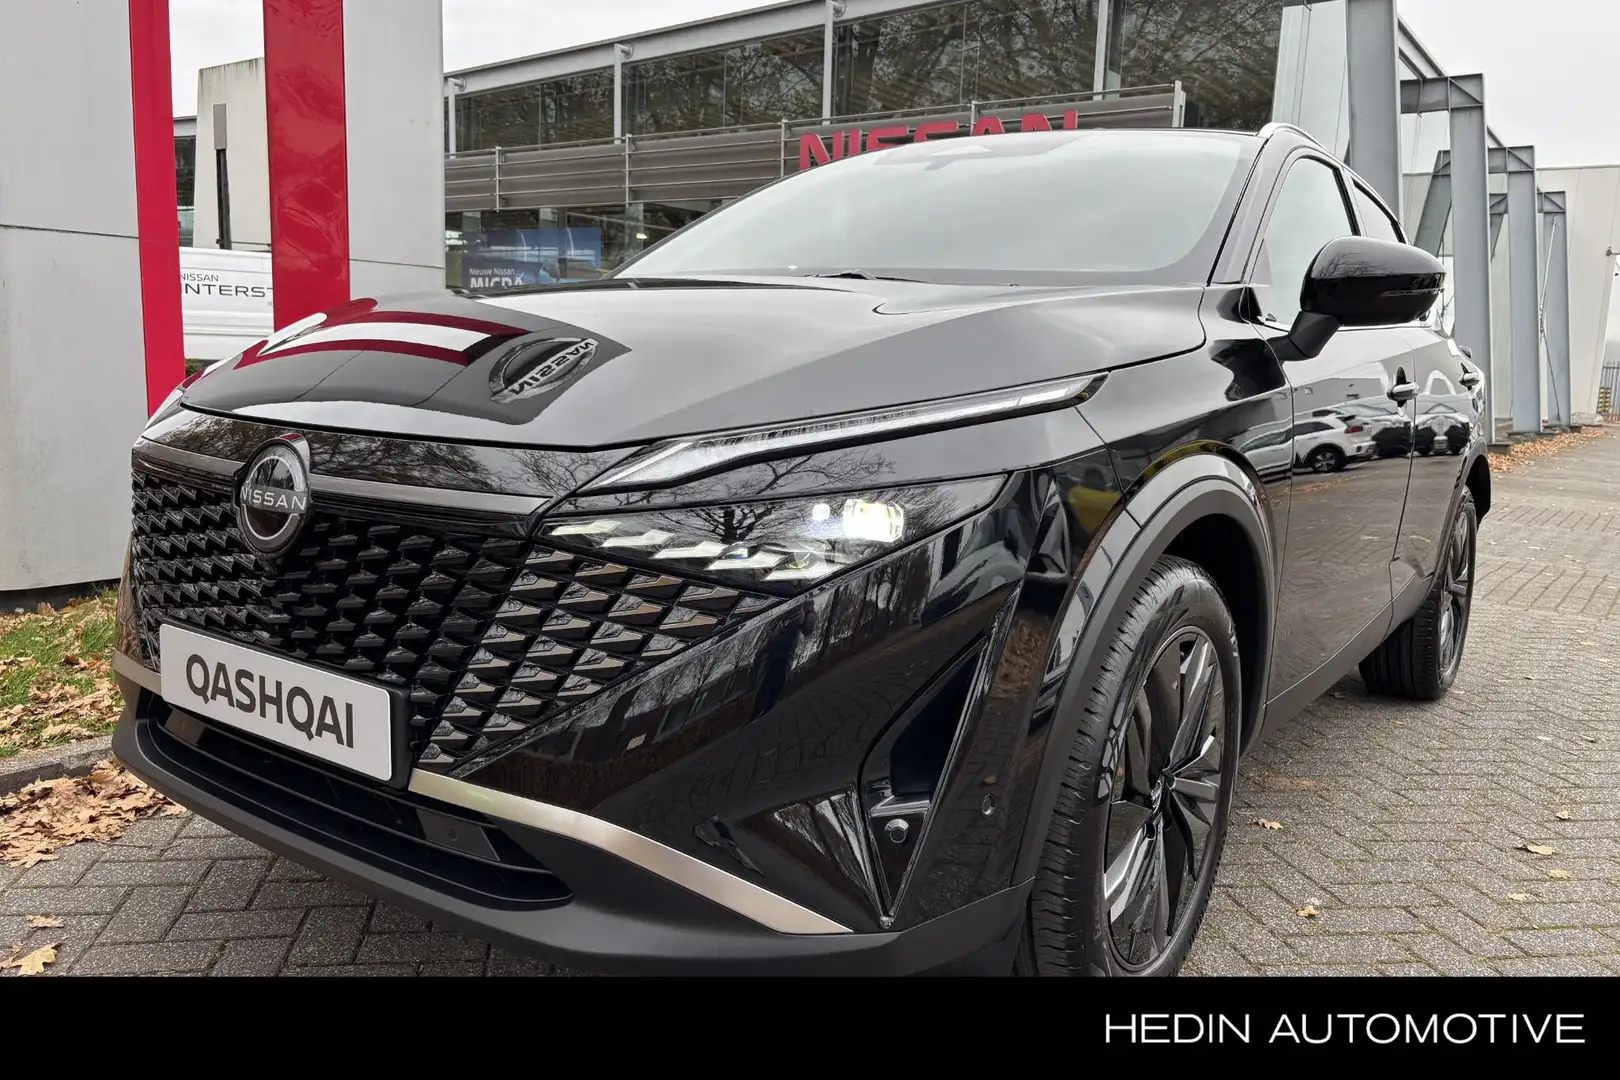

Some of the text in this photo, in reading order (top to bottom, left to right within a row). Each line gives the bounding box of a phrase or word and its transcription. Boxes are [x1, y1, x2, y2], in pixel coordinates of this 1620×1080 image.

[493, 268, 515, 276] Nissan
[240, 485, 307, 511] NISSAN
[186, 654, 354, 749] QASHQAI
